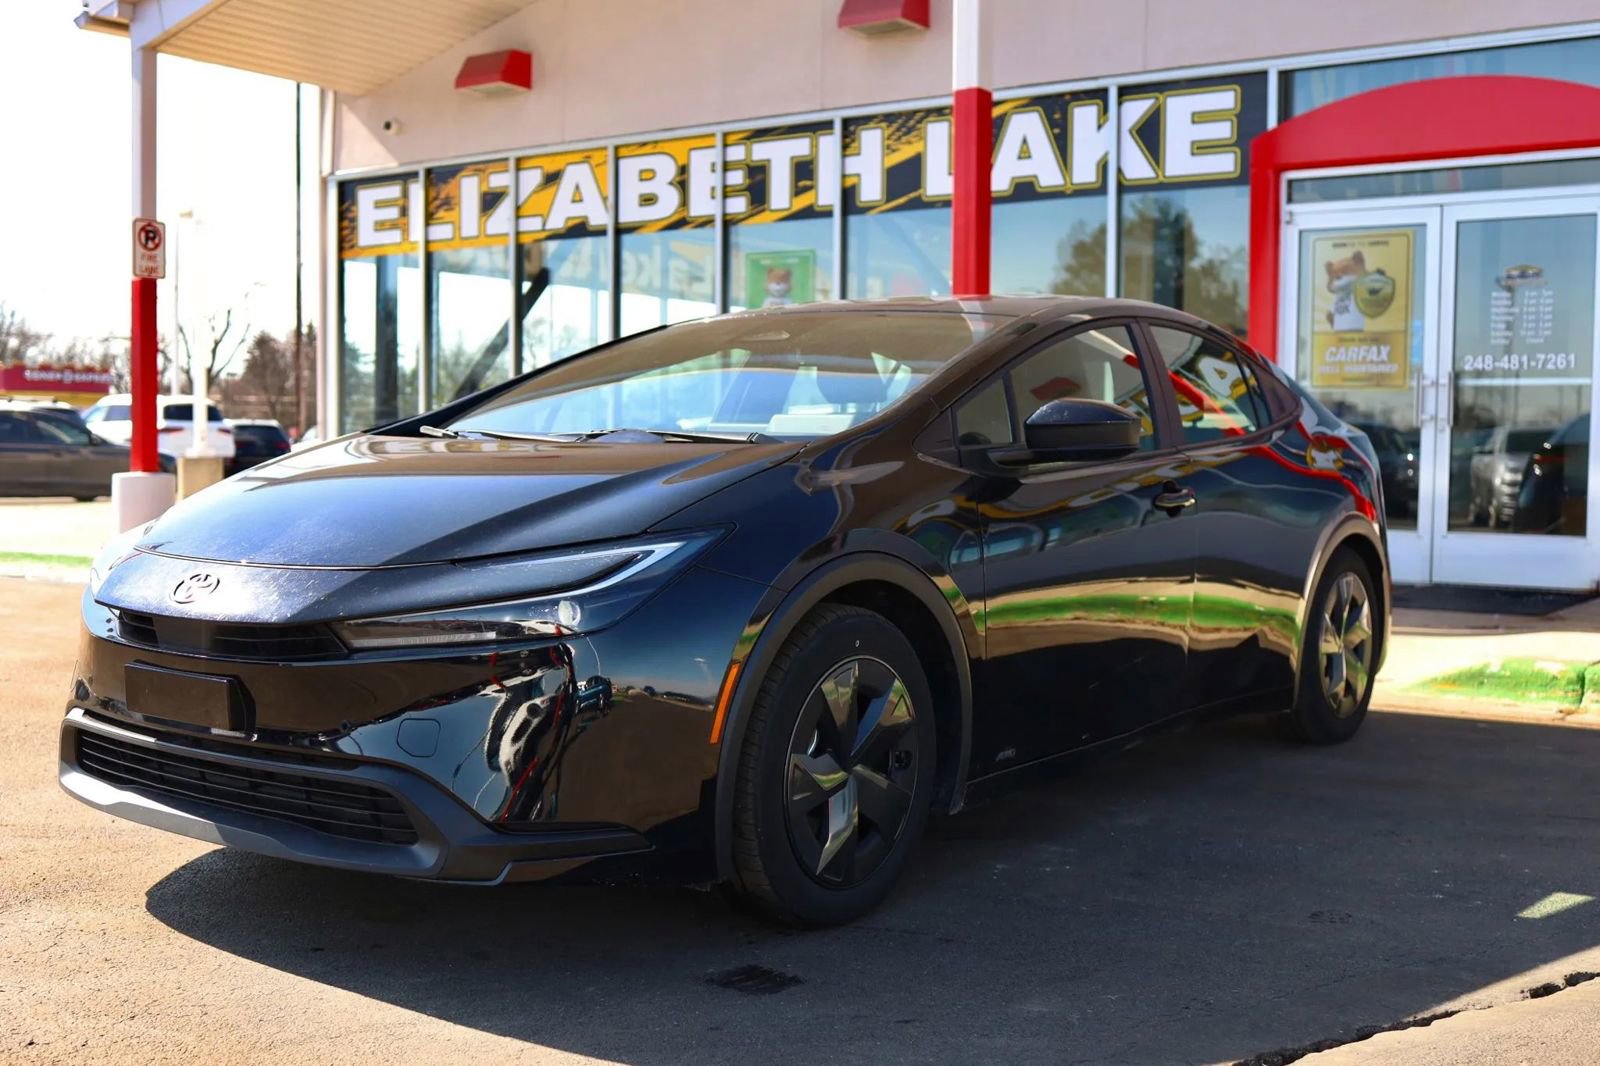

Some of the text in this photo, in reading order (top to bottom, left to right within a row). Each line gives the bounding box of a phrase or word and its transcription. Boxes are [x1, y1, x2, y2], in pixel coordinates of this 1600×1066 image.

[355, 85, 1241, 248] ELIZABETH LAKE
[1325, 344, 1391, 363] CARFAX
[1463, 352, 1576, 371] 248-481-7261
